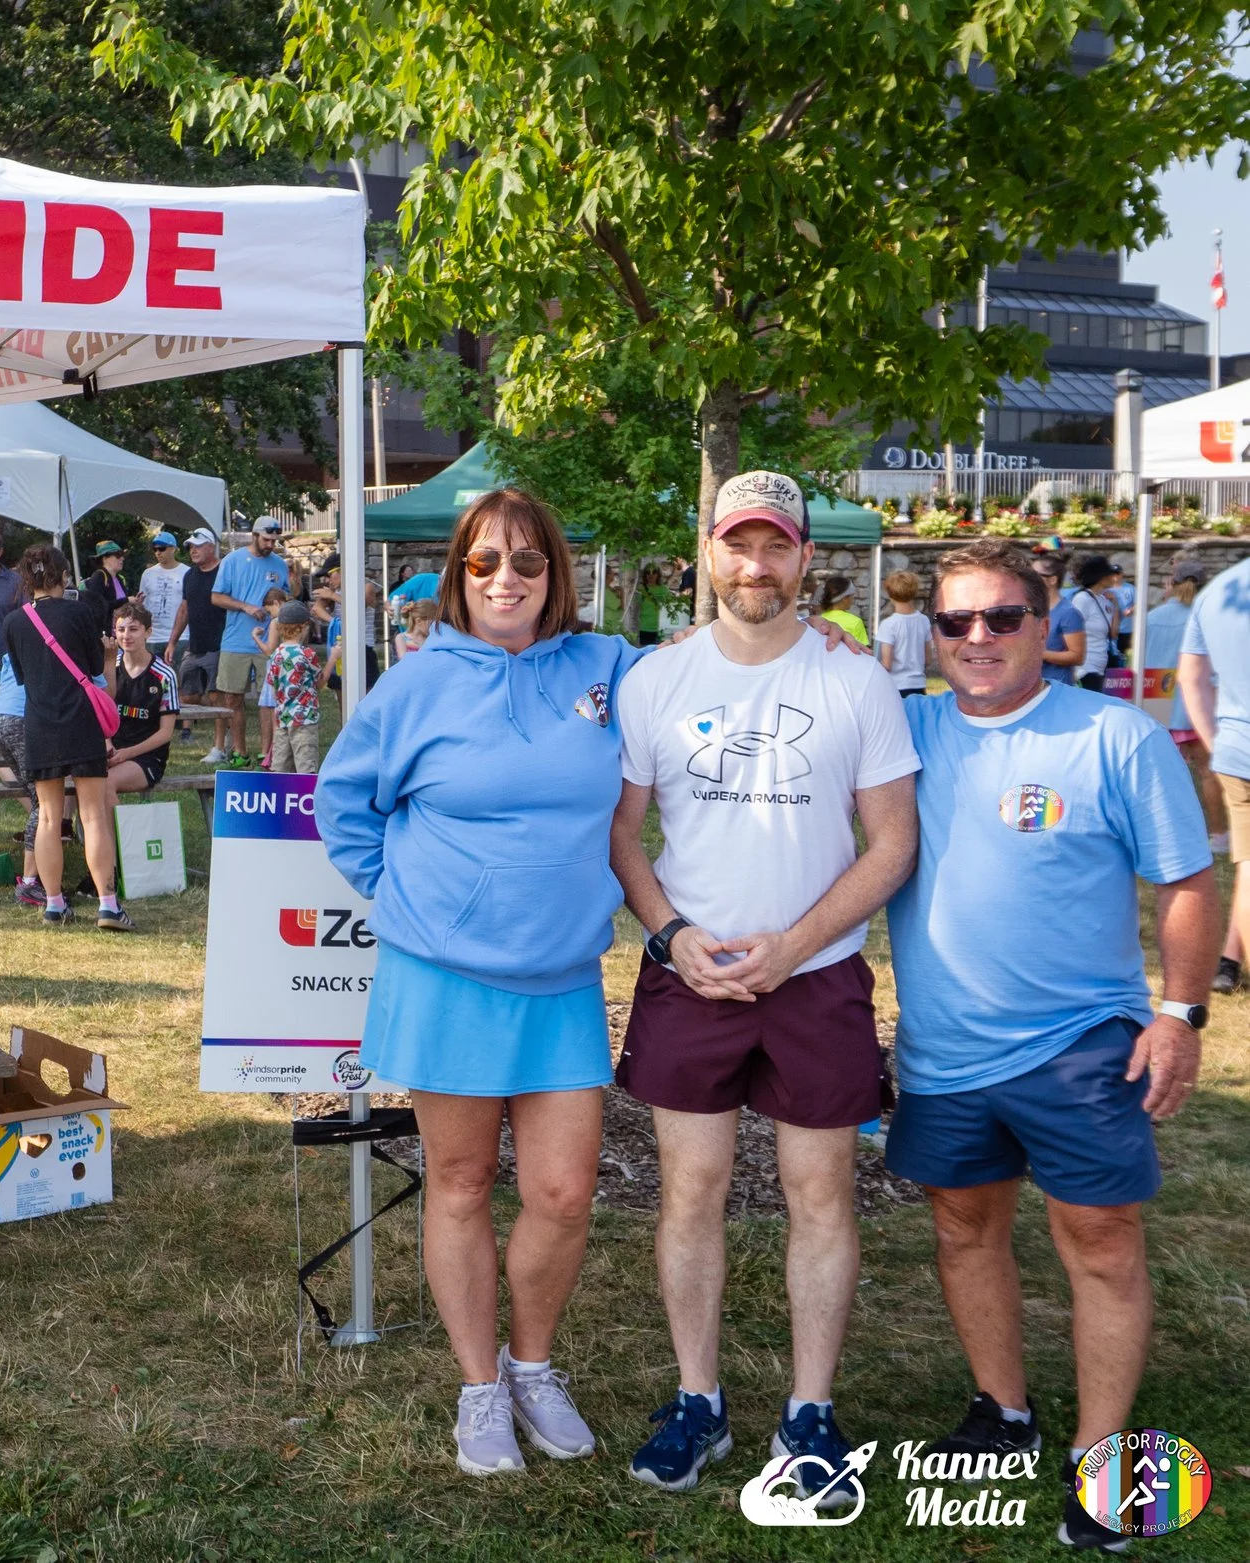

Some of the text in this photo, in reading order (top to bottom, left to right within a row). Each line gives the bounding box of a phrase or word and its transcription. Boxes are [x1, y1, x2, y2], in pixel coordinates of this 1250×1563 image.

[765, 476, 797, 501] TIGERS
[123, 705, 149, 719] UNITES
[1021, 786, 1036, 794] FOR
[225, 791, 314, 815] RUN FO
[692, 790, 811, 805] UNDER ARMOUR
[148, 843, 161, 857] TD
[291, 975, 353, 992] SNACK
[246, 1065, 307, 1075] windsorpride
[255, 1075, 302, 1085] community
[341, 1072, 362, 1083] Fest
[58, 1124, 84, 1139] best
[61, 1133, 94, 1150] snack
[59, 1148, 89, 1162] ever
